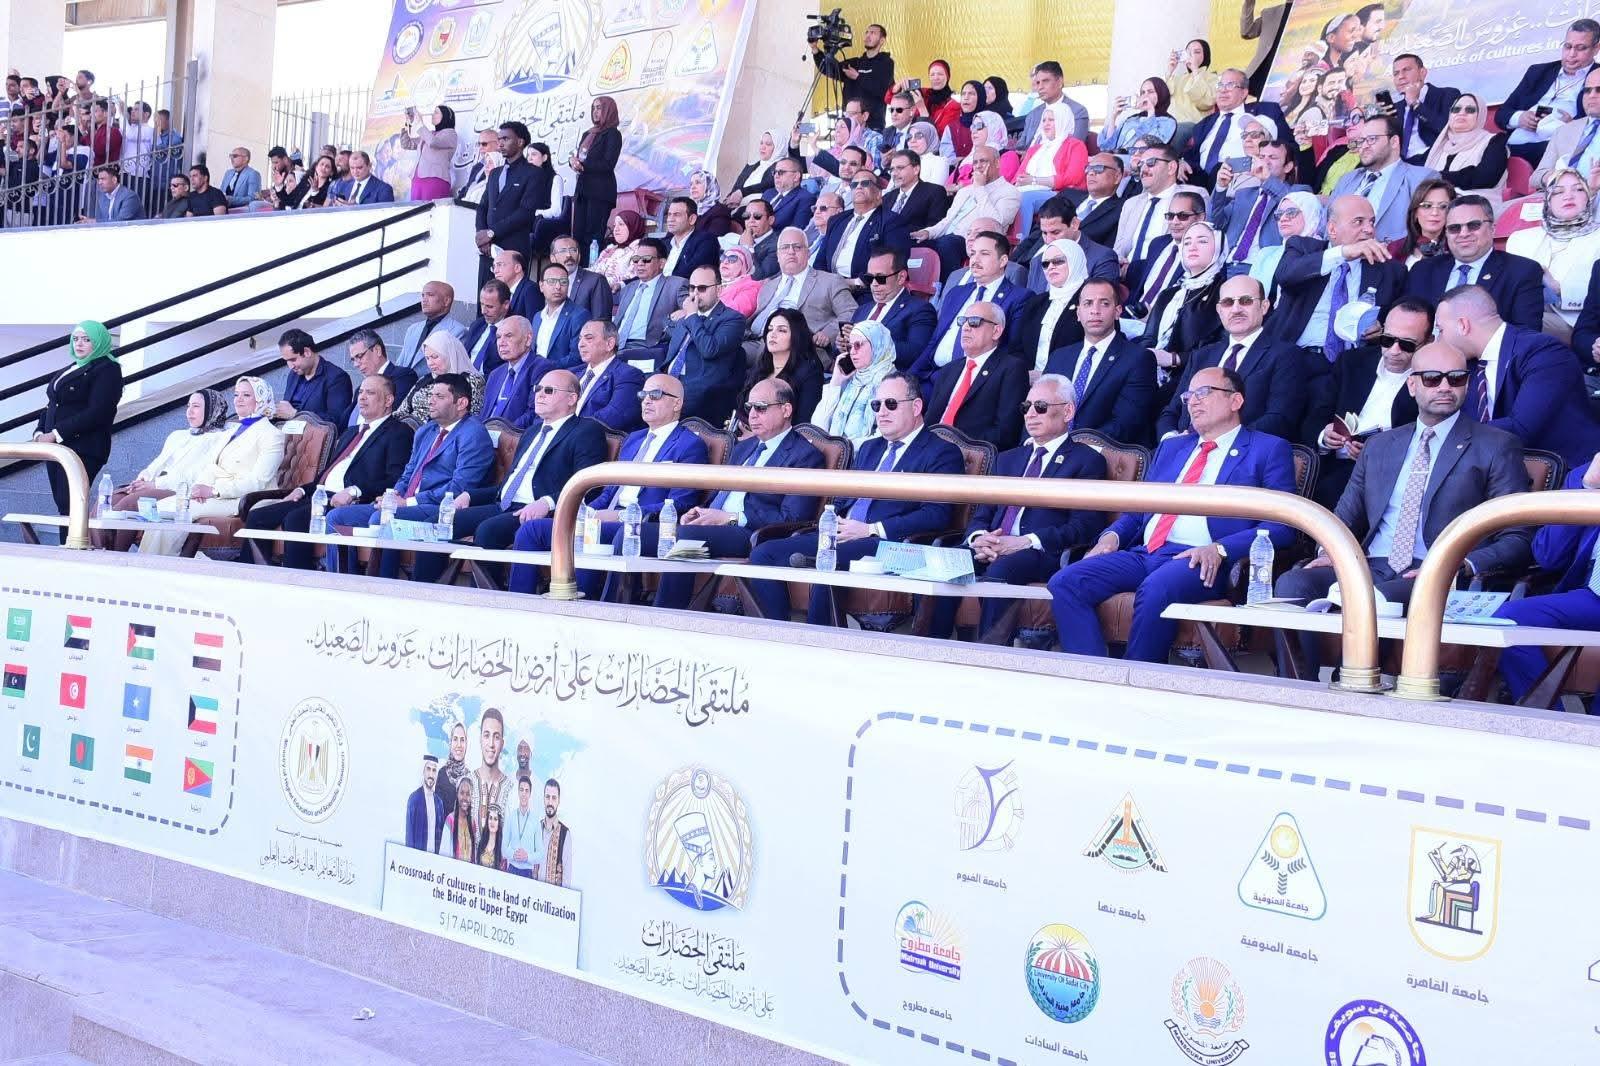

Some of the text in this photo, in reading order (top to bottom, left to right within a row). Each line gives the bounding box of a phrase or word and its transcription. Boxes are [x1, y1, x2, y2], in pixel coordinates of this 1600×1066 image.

[1469, 51, 1485, 63] of
[1487, 41, 1546, 60] cultures
[390, 860, 577, 922] A crossroads of cultures in the land of civilization
[983, 875, 1008, 893] جامعة
[432, 886, 529, 925] the Bride of Upper Egypt
[1098, 900, 1146, 924] جامعة بنها
[460, 917, 489, 939] APRIL
[491, 926, 515, 946] 2026
[933, 943, 961, 964] جامعة
[1240, 935, 1319, 965] جامعة المنوفية
[928, 960, 961, 979] University
[1406, 973, 1489, 1006] جامعة القاهرة
[902, 1000, 953, 1021] جامعة مطروح
[1024, 1034, 1090, 1065] جامعة السادات
[1173, 1029, 1240, 1065] MANSOURA UNIVERSITY
